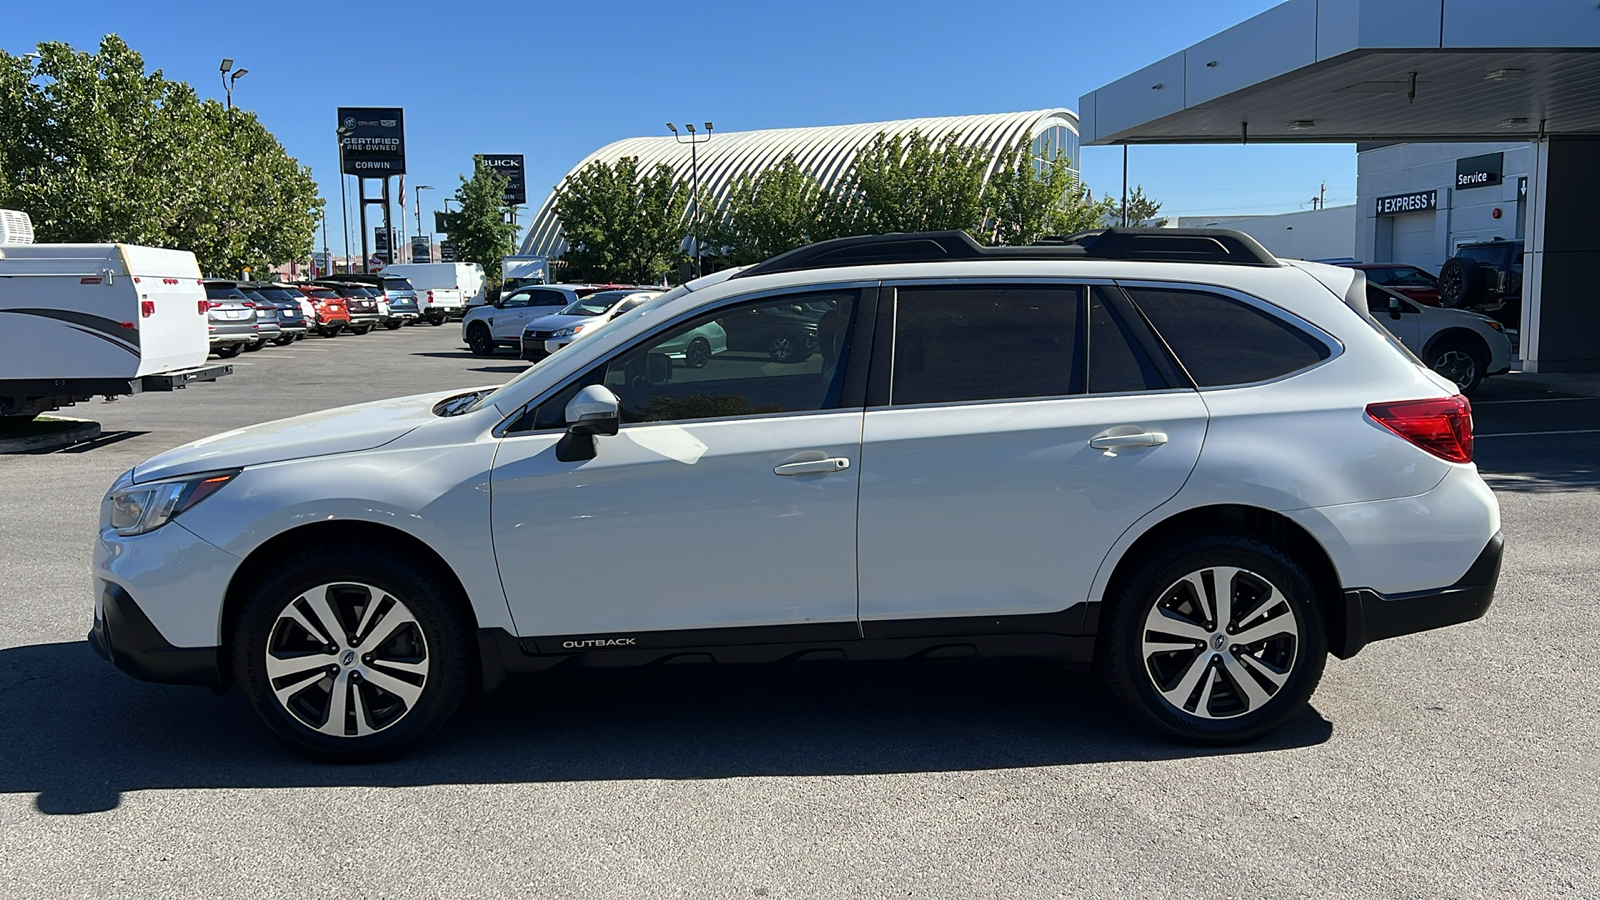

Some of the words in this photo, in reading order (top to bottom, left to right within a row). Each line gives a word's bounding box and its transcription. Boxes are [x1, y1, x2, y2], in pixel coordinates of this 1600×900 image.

[343, 137, 400, 145] CERTIFIED
[355, 161, 390, 169] CORWIN
[481, 159, 521, 167] BUICK
[1458, 171, 1487, 185] Service
[1384, 194, 1428, 213] EXPRESS
[563, 638, 636, 648] OUTBACK
